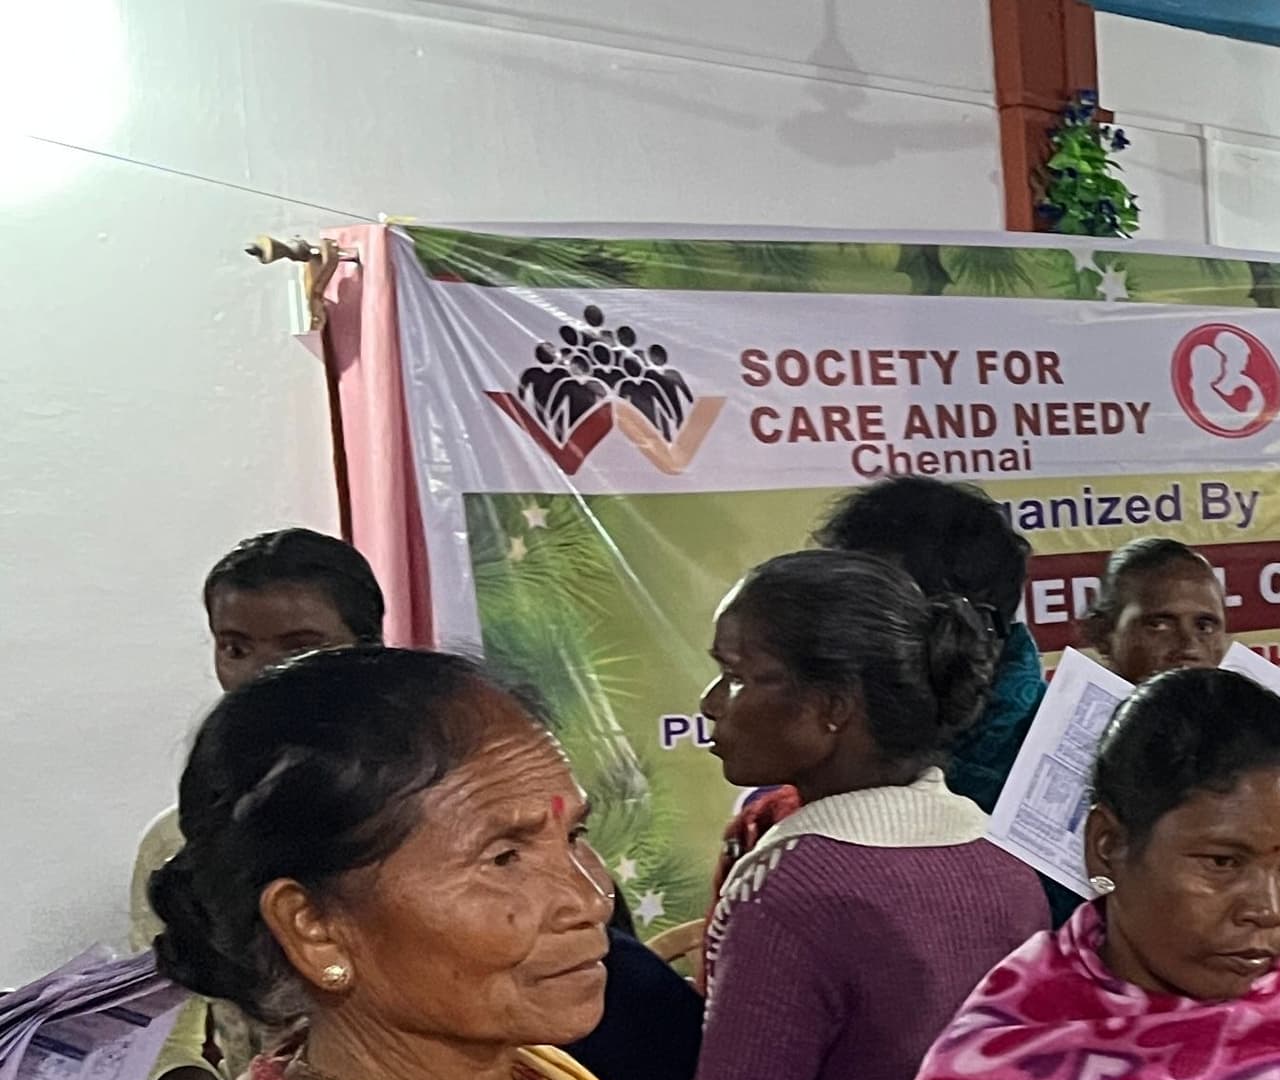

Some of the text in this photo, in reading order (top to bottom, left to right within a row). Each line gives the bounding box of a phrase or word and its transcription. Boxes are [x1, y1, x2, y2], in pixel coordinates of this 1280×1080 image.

[740, 349, 1064, 387] SOCIETY FOR
[750, 401, 1151, 444] CARE AND NEEDY
[851, 440, 1033, 478] Chennai
[1004, 482, 1260, 531] anized By
